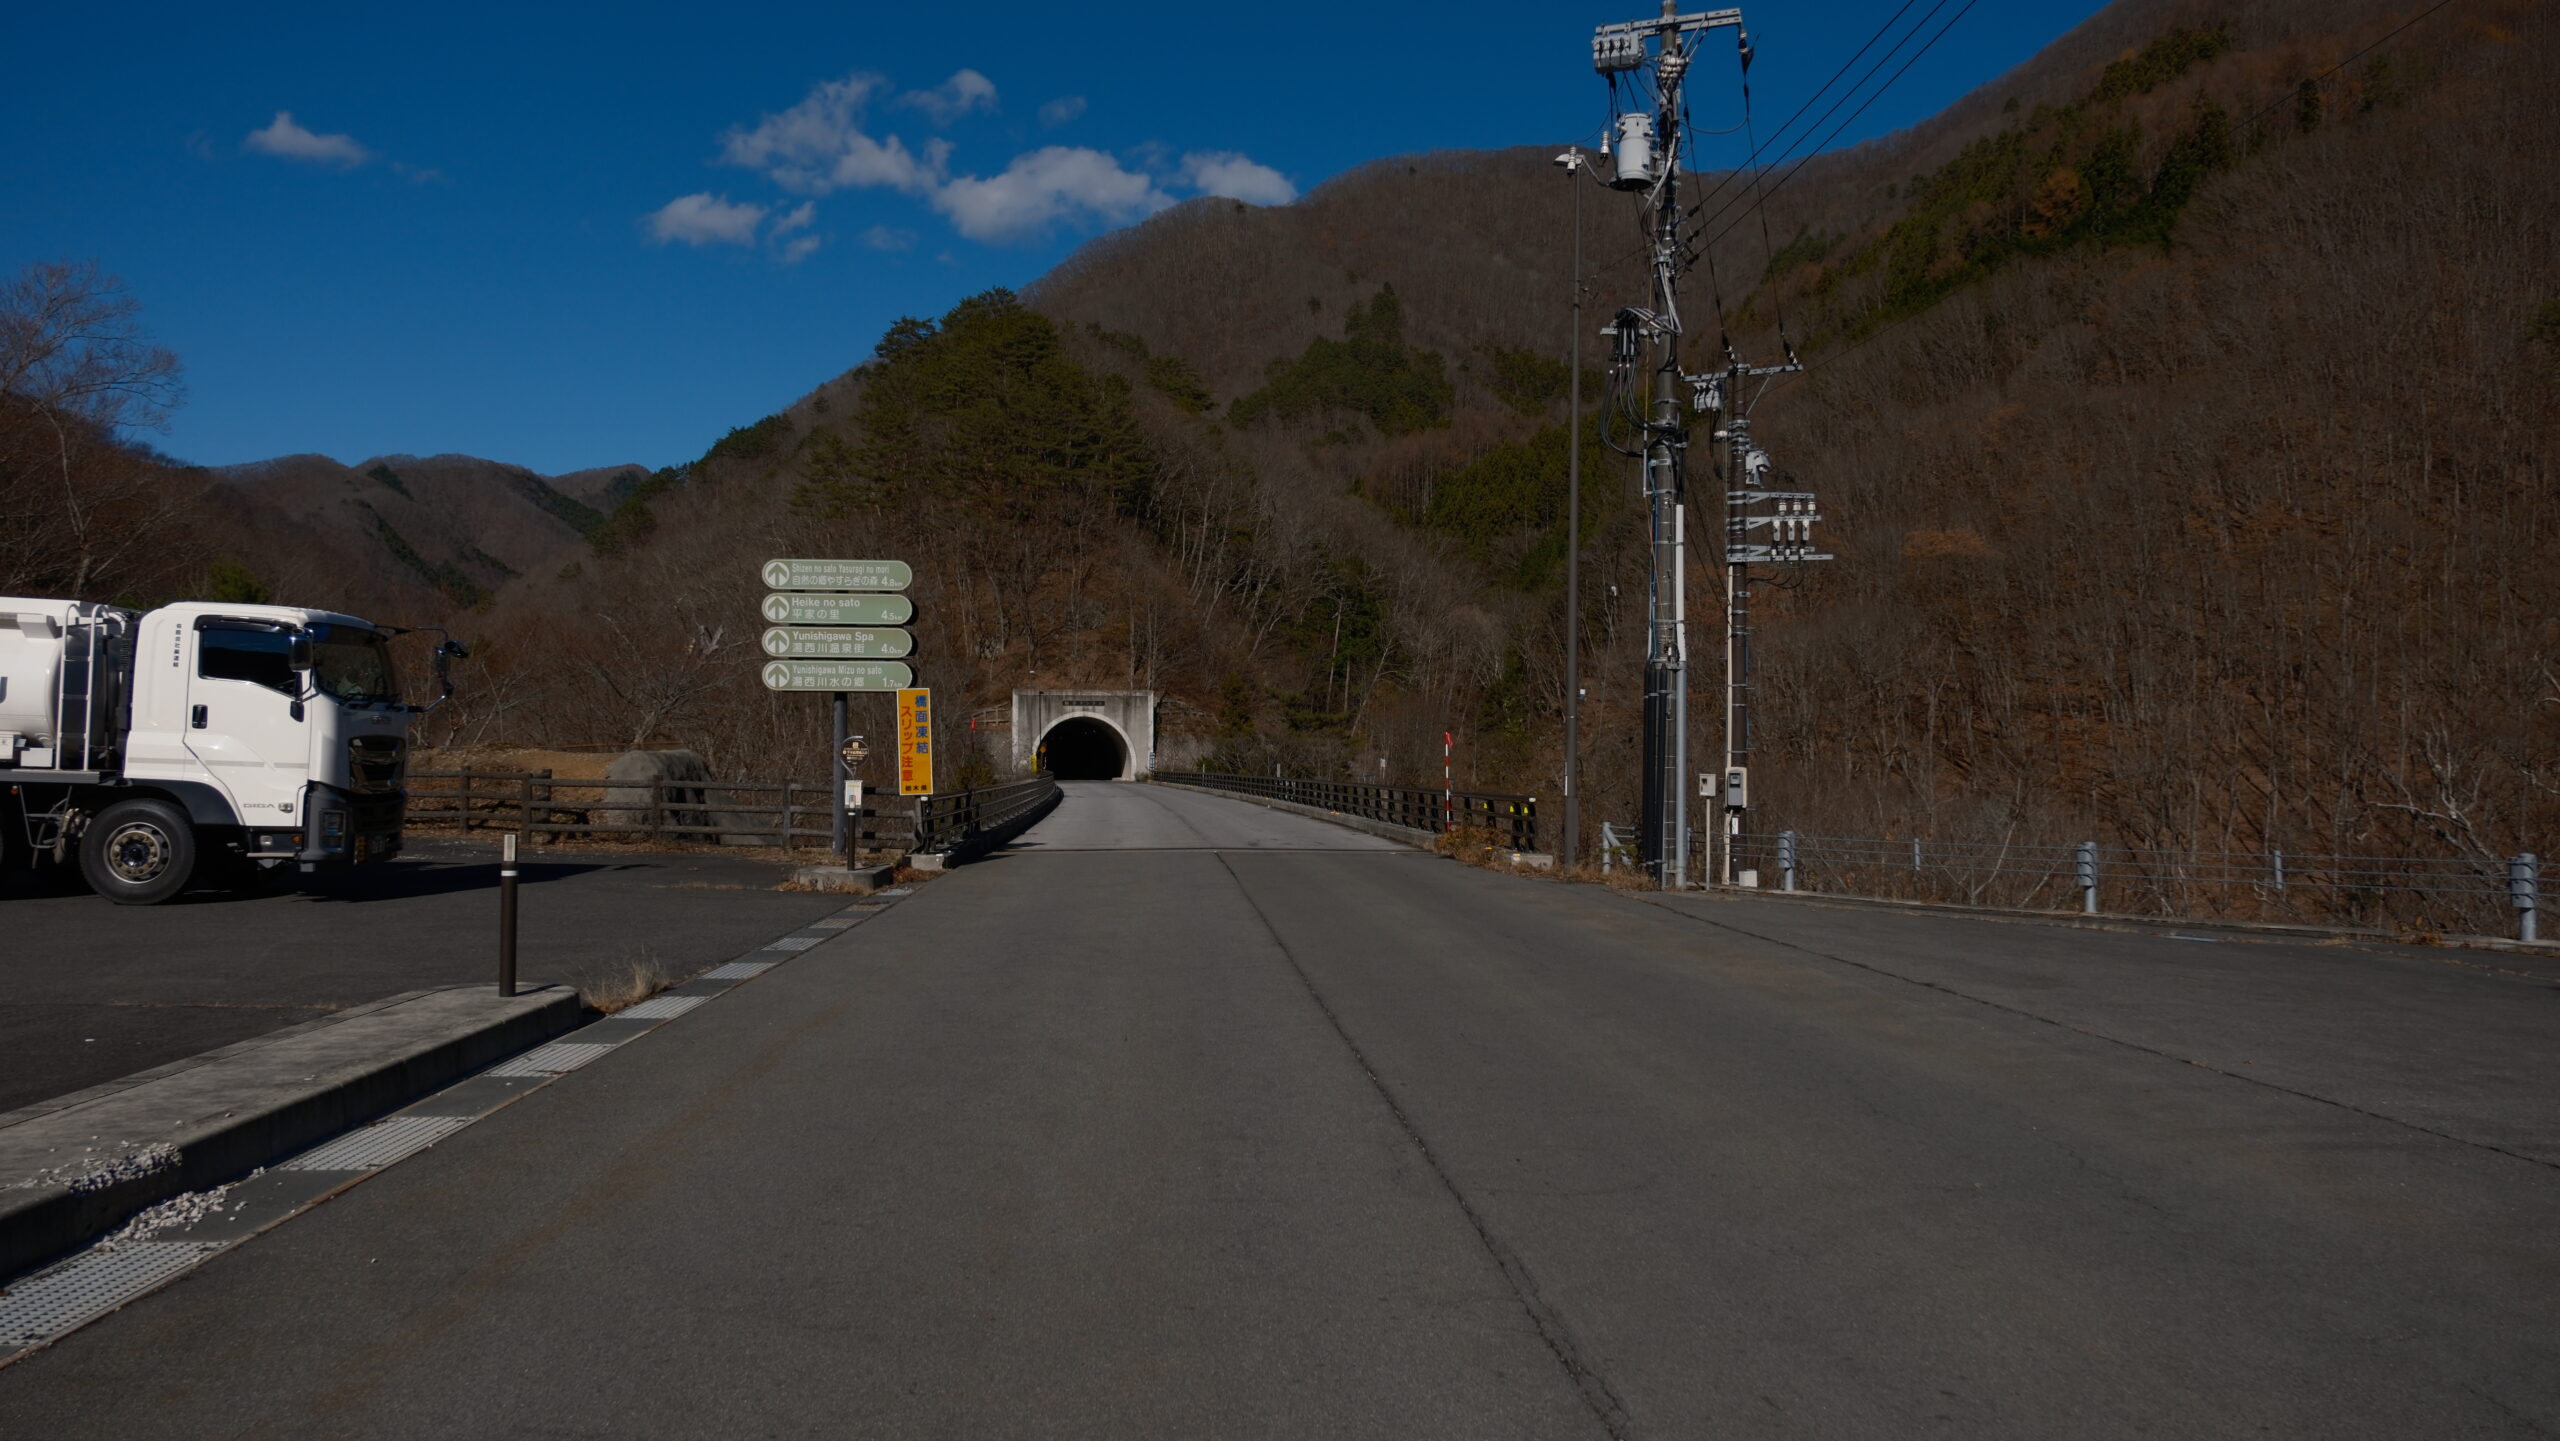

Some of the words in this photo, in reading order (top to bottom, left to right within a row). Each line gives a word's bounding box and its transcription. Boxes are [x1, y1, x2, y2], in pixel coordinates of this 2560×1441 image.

[792, 563, 813, 573] Shizen
[814, 565, 822, 573] no
[823, 564, 836, 573] sato
[838, 564, 865, 575] Yasuragi
[866, 566, 874, 574] no
[875, 565, 890, 574] mori
[792, 597, 820, 607] Heike
[823, 599, 836, 607] no
[838, 598, 861, 607] sato
[792, 608, 840, 620] 平家の里
[792, 631, 852, 642] Yunishigawa
[855, 631, 874, 643] Spa
[792, 642, 865, 654] 湯西川温泉街
[792, 665, 836, 675] Yunishigawa
[838, 665, 855, 674] Mizu
[867, 665, 882, 675] sato
[901, 706, 914, 782] スリップ注意
